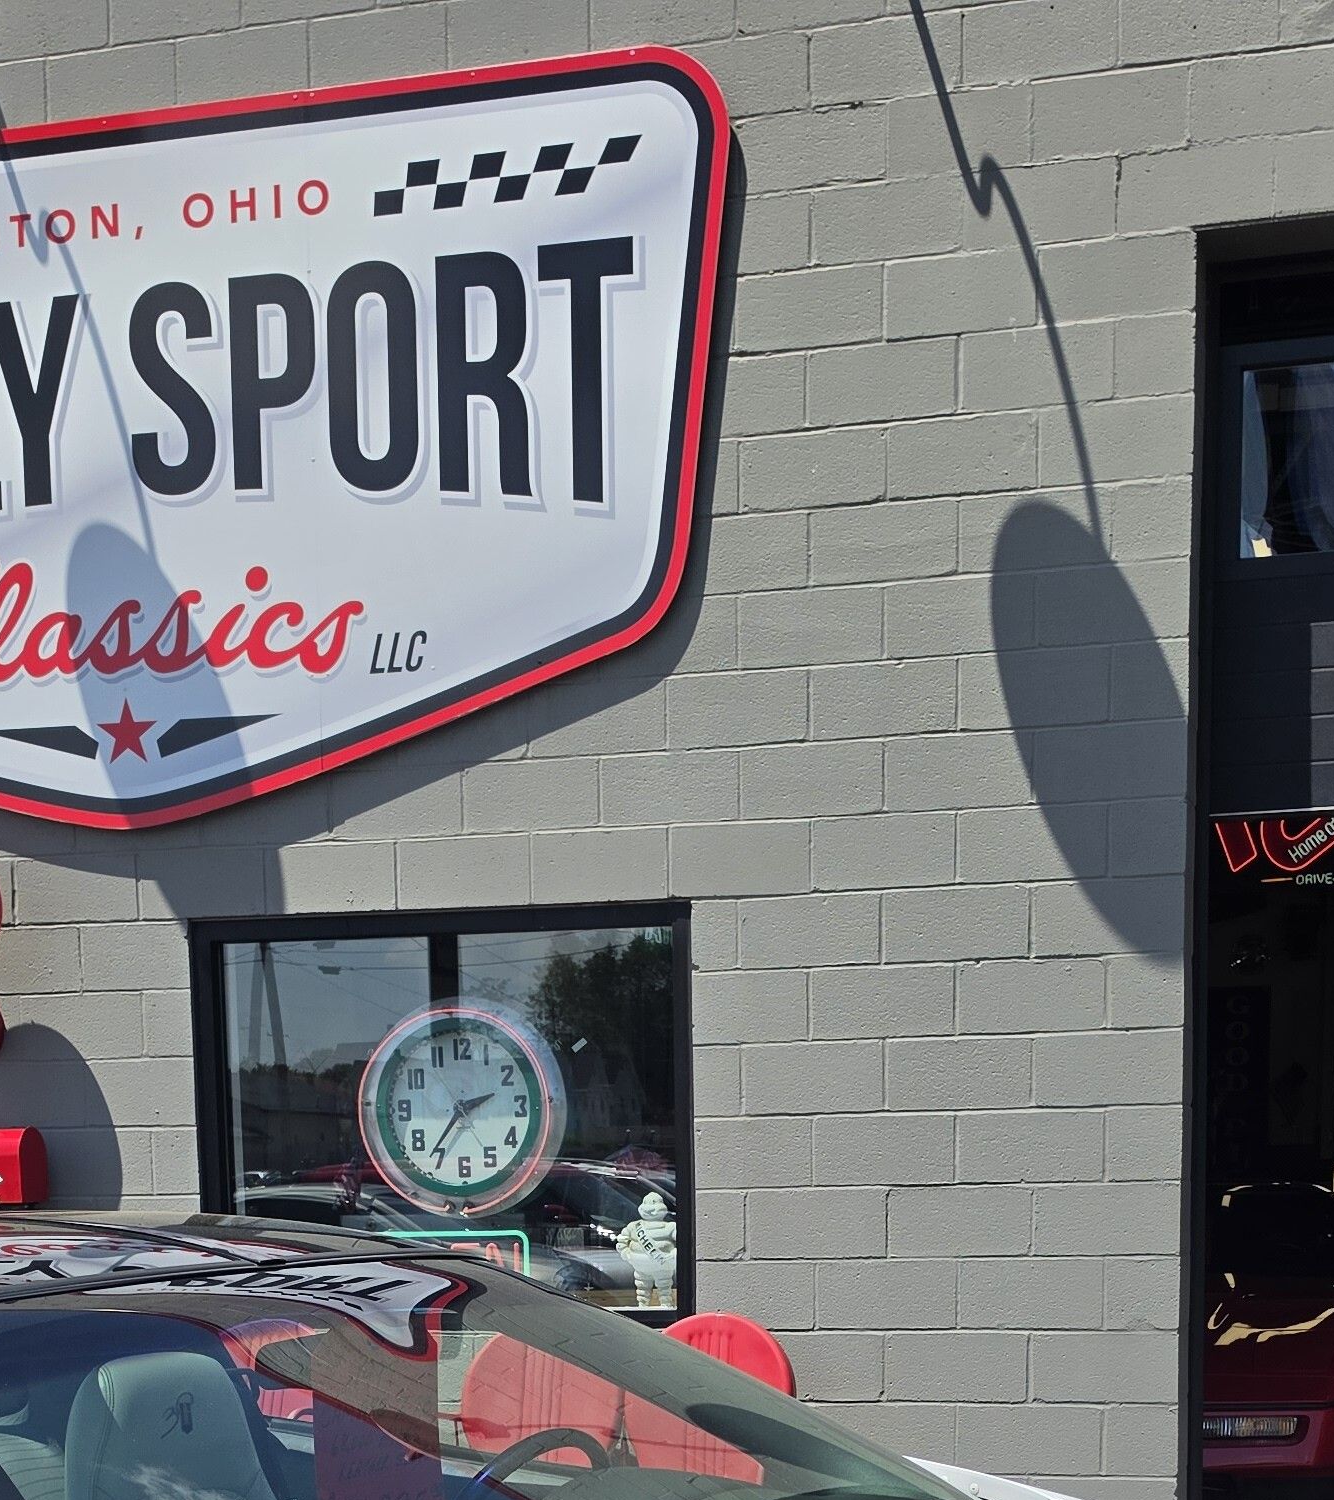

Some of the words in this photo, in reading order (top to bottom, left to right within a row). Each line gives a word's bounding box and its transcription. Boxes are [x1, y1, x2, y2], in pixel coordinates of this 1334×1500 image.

[182, 179, 331, 228] OHIO
[129, 236, 634, 502] SPORT
[369, 630, 428, 676] LLC
[1287, 829, 1328, 864] Home
[431, 1046, 444, 1068] 11
[453, 1038, 471, 1061] 12
[483, 1044, 489, 1066] 1
[407, 1068, 425, 1091] 10
[500, 1064, 514, 1086] 2
[398, 1099, 412, 1122] 9
[514, 1094, 527, 1118] 3
[411, 1128, 426, 1151] 8
[504, 1126, 518, 1149] 4
[434, 1147, 446, 1170] 7
[457, 1156, 472, 1178] 6
[483, 1146, 497, 1168] 5
